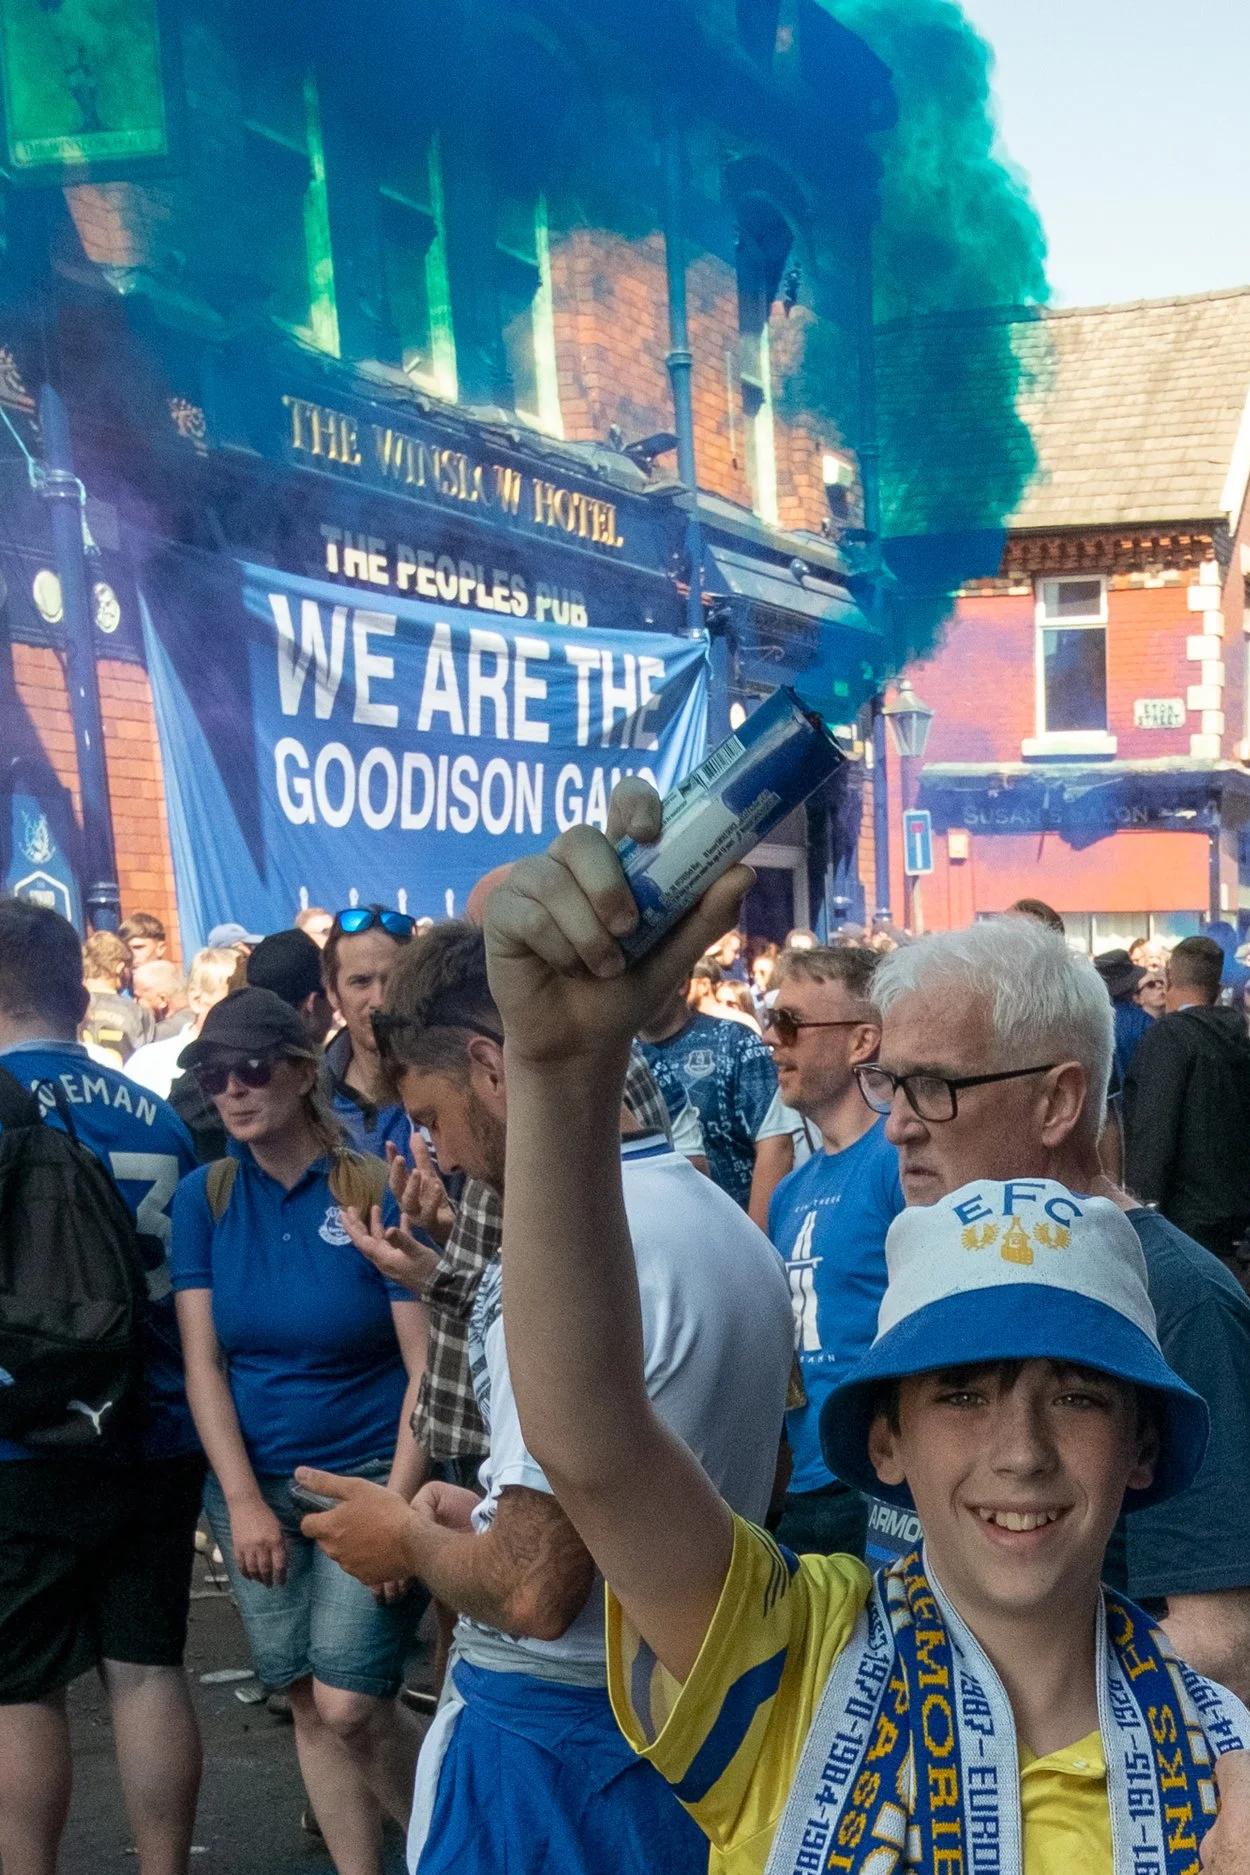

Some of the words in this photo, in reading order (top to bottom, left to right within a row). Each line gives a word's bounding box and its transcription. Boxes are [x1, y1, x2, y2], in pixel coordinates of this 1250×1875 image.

[282, 396, 361, 466] THE
[533, 478, 624, 548] HOTEL
[321, 524, 390, 588] THE
[396, 541, 529, 618] PEOPLES
[534, 582, 589, 629] PUB
[268, 593, 399, 729] WE
[417, 622, 551, 744] ARE
[564, 644, 667, 752] THE
[274, 737, 544, 836] GOODISON
[868, 1504, 924, 1544] ARMO
